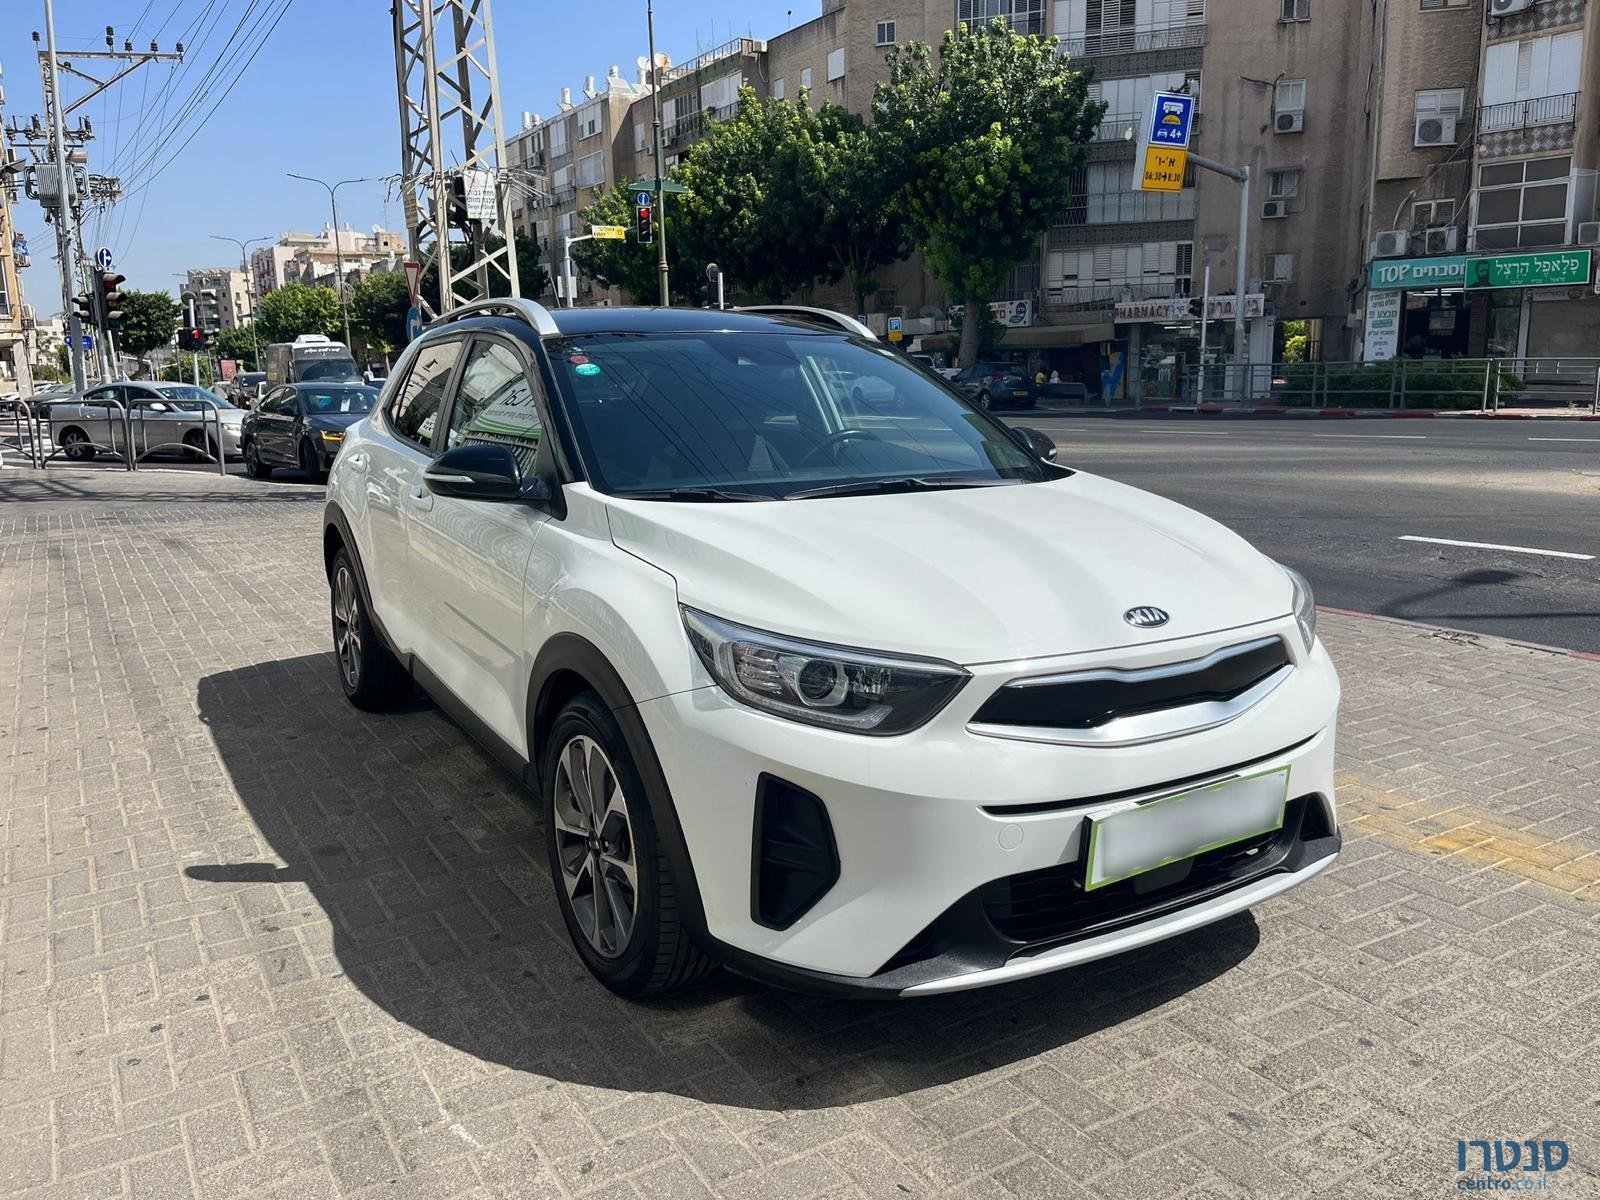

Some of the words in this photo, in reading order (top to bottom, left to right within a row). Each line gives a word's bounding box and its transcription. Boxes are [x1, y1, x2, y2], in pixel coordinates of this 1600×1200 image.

[1378, 264, 1411, 283] TOP
[1114, 305, 1169, 319] PHARMACY
[1128, 608, 1167, 623] KIA
